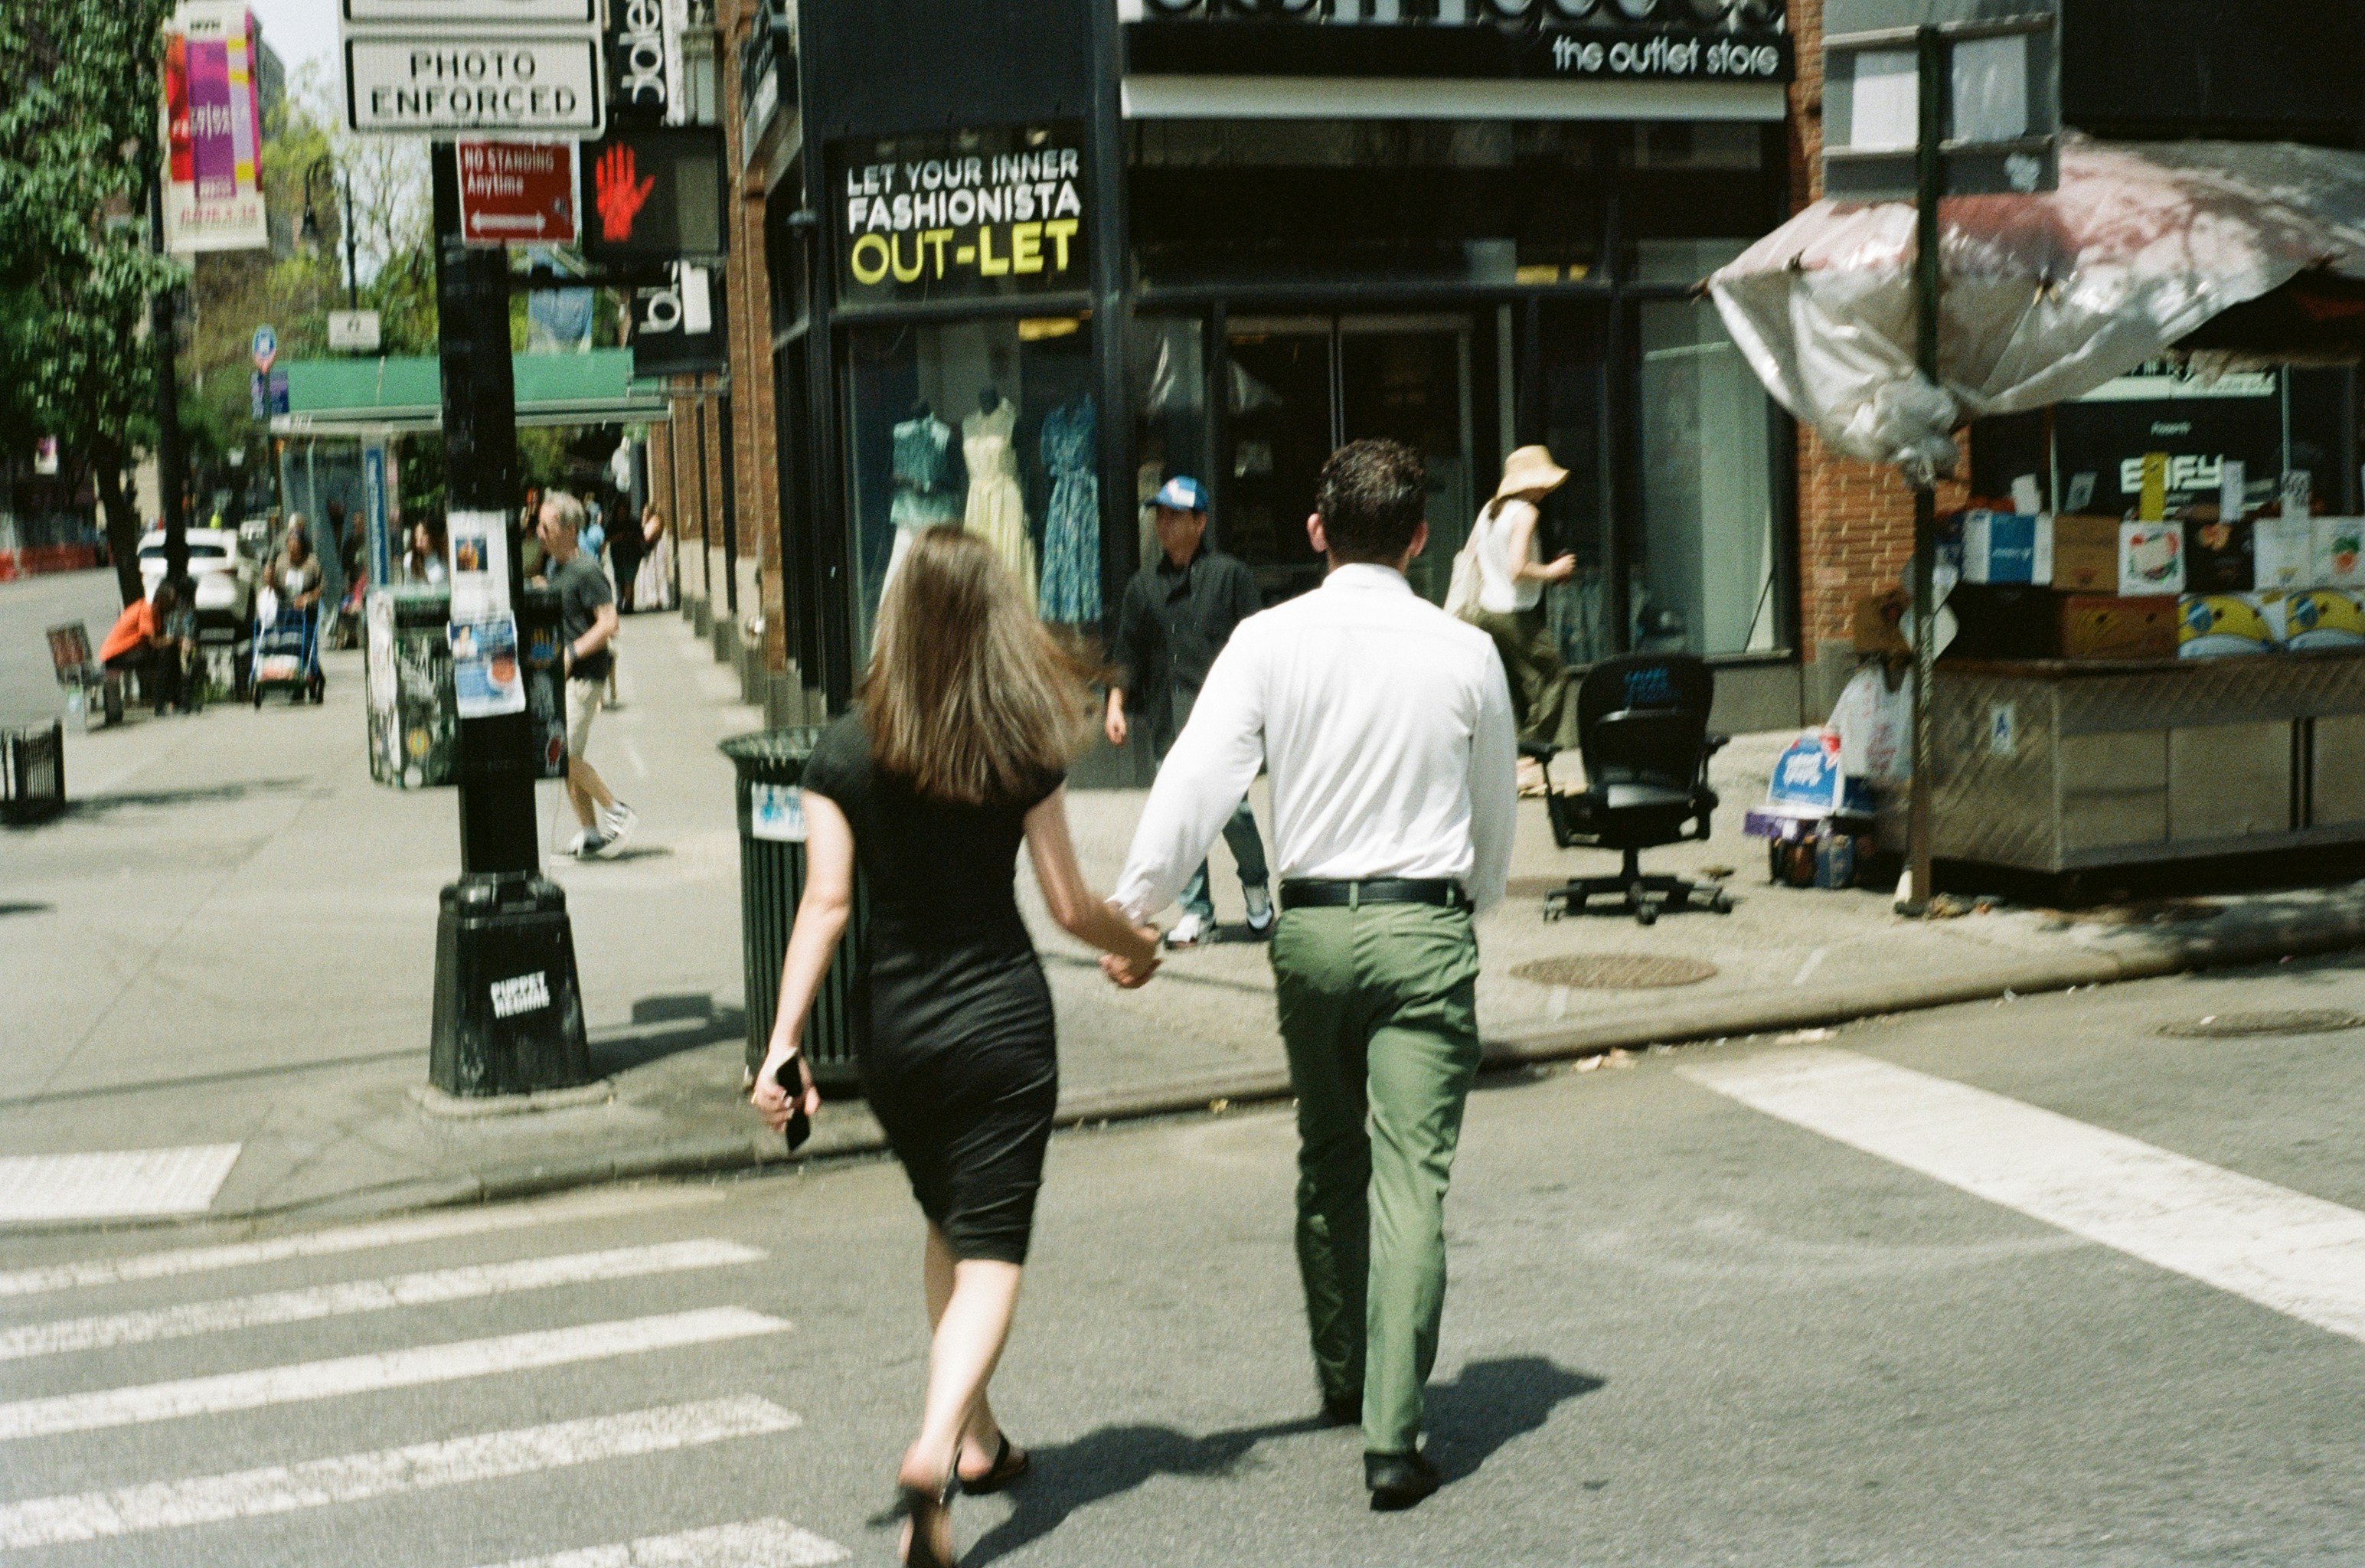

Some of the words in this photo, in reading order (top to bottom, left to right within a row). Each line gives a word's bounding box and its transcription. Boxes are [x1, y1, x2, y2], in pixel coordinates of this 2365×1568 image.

[410, 50, 535, 80] PHOTO
[1553, 34, 1604, 73] the
[1609, 35, 1700, 74] outlet
[1706, 38, 1779, 75] store
[371, 85, 576, 116] ENFORCED
[465, 147, 484, 173] NO
[487, 147, 554, 175] STANDING
[848, 162, 897, 197] LET
[906, 156, 982, 192] YOUR
[992, 149, 1079, 185] INNER
[467, 169, 524, 201] Anytime
[848, 180, 1081, 234] FASHIONISTA
[851, 218, 1079, 285] OUT-LET
